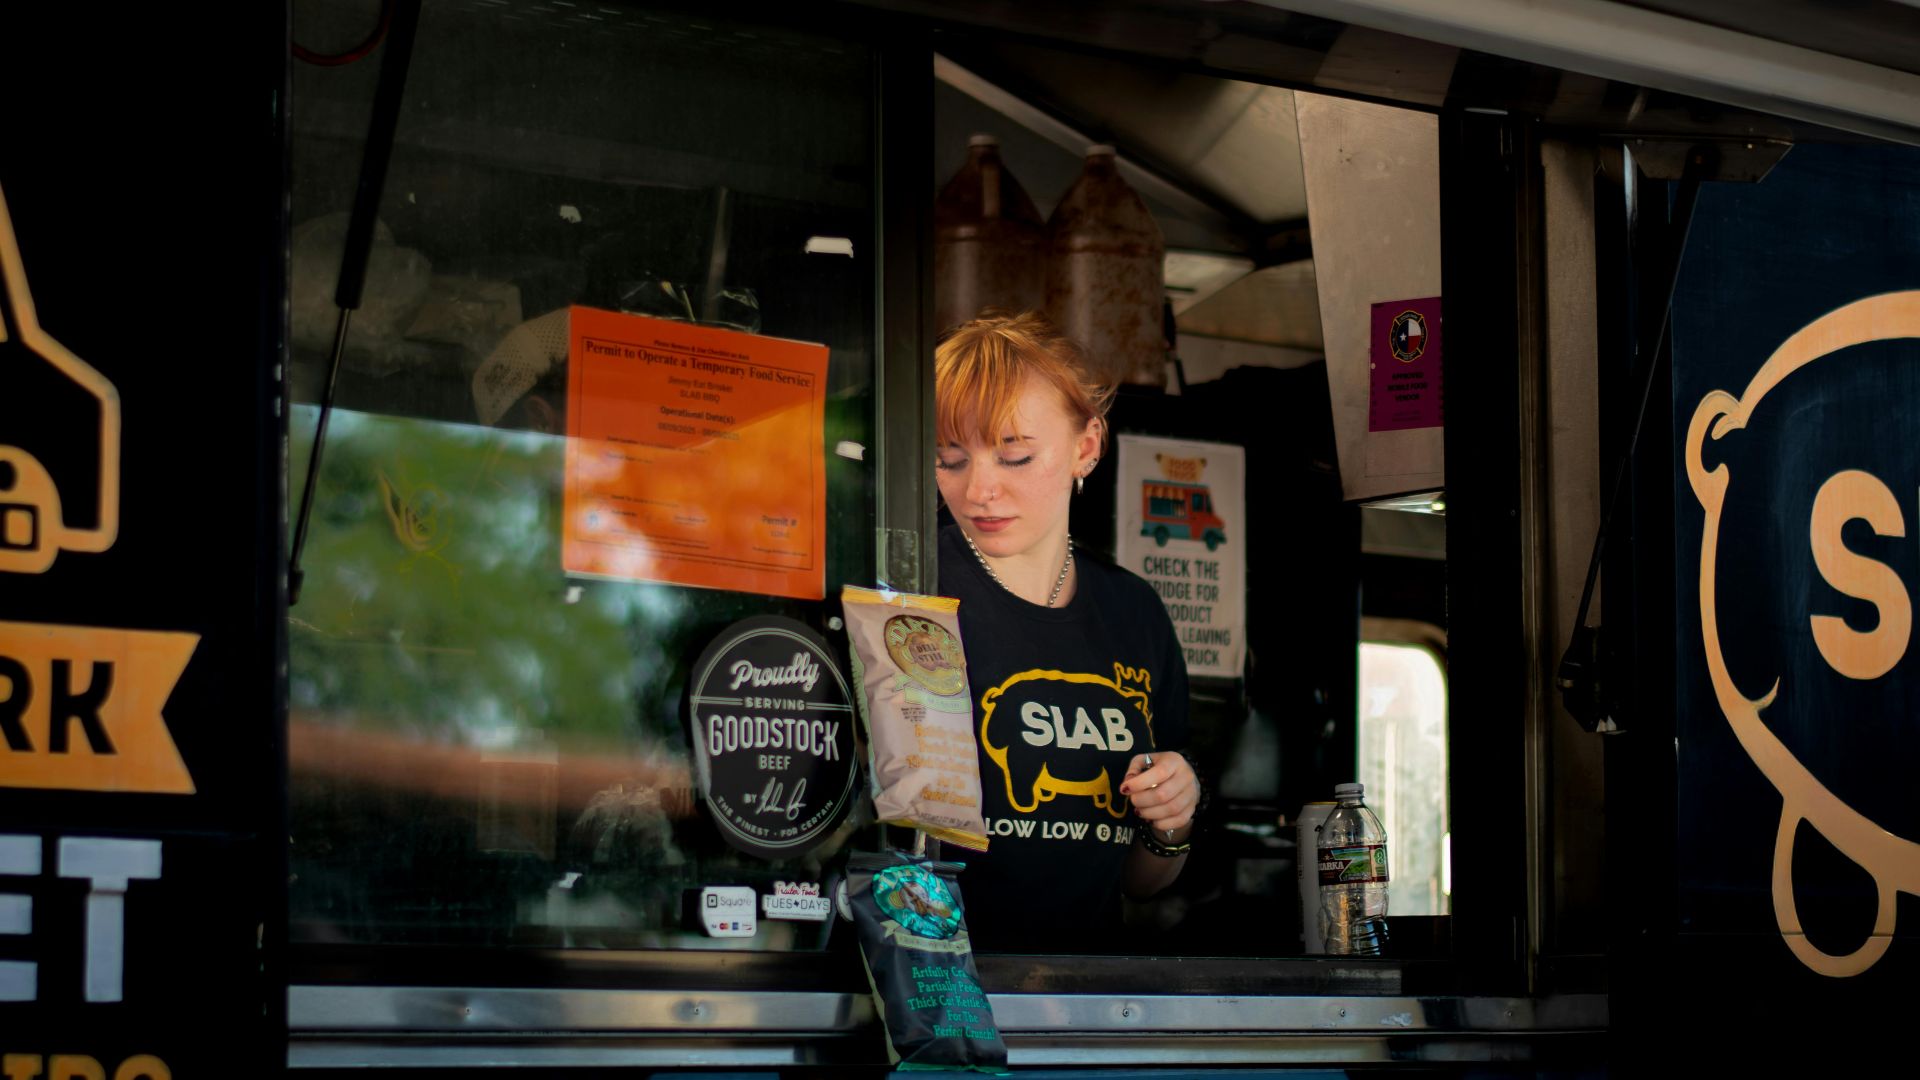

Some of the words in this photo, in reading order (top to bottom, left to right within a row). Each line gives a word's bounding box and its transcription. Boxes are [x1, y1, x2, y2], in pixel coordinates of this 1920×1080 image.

[585, 340, 621, 357] Permit
[625, 348, 636, 359] to
[638, 349, 678, 365] Operate
[680, 358, 688, 367] a
[690, 357, 745, 380] Temporary
[749, 366, 774, 382] Food
[775, 371, 812, 388] Service
[660, 405, 704, 420] Operational
[1143, 555, 1191, 578] CHECK
[1194, 560, 1220, 581] THE
[1809, 468, 1920, 681] S
[1149, 580, 1192, 600] RIDGE
[1196, 584, 1220, 603] FOR
[1182, 626, 1231, 646] LEAVING
[729, 651, 820, 693] Proudly
[744, 696, 806, 711] SERVING
[1020, 701, 1134, 752] SLAB
[708, 713, 840, 762] GOODSTOCK
[758, 754, 792, 771] BEEF
[743, 793, 758, 804] BY
[716, 795, 734, 817] THE
[735, 815, 771, 838] FINEST
[780, 825, 799, 838] FOR
[801, 799, 834, 832] CERTAIN
[985, 817, 1037, 839] LOW
[1042, 820, 1090, 841] LOW
[720, 896, 752, 908] Square
[911, 965, 950, 980] Artfully
[916, 979, 957, 994] Partially
[907, 995, 938, 1010] Thick
[964, 1025, 996, 1040] Crunch!
